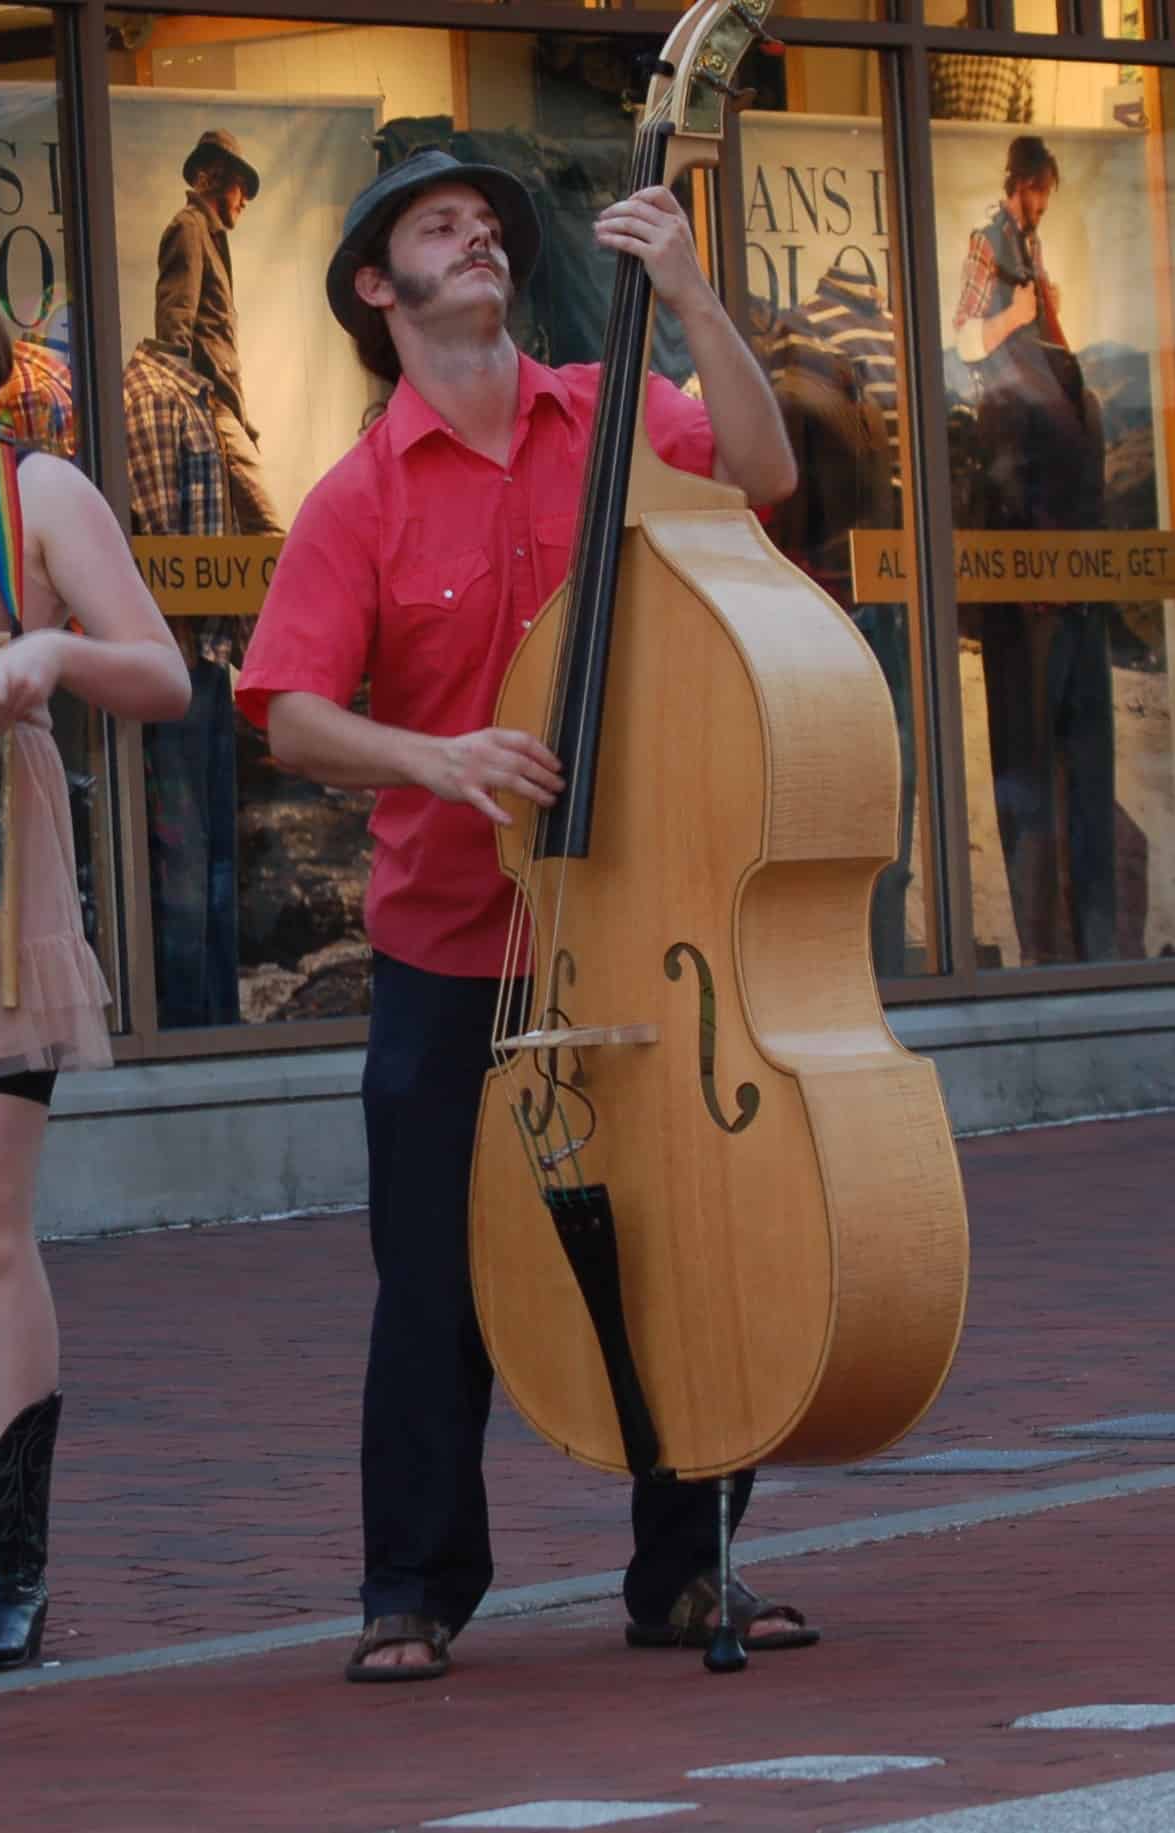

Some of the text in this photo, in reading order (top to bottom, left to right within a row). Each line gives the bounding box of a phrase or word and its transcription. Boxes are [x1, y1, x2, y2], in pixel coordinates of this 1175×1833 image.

[195, 557, 250, 589] BUY
[1013, 549, 1058, 578] BUY
[1067, 548, 1121, 582] ONE,
[1128, 547, 1169, 577] GET
